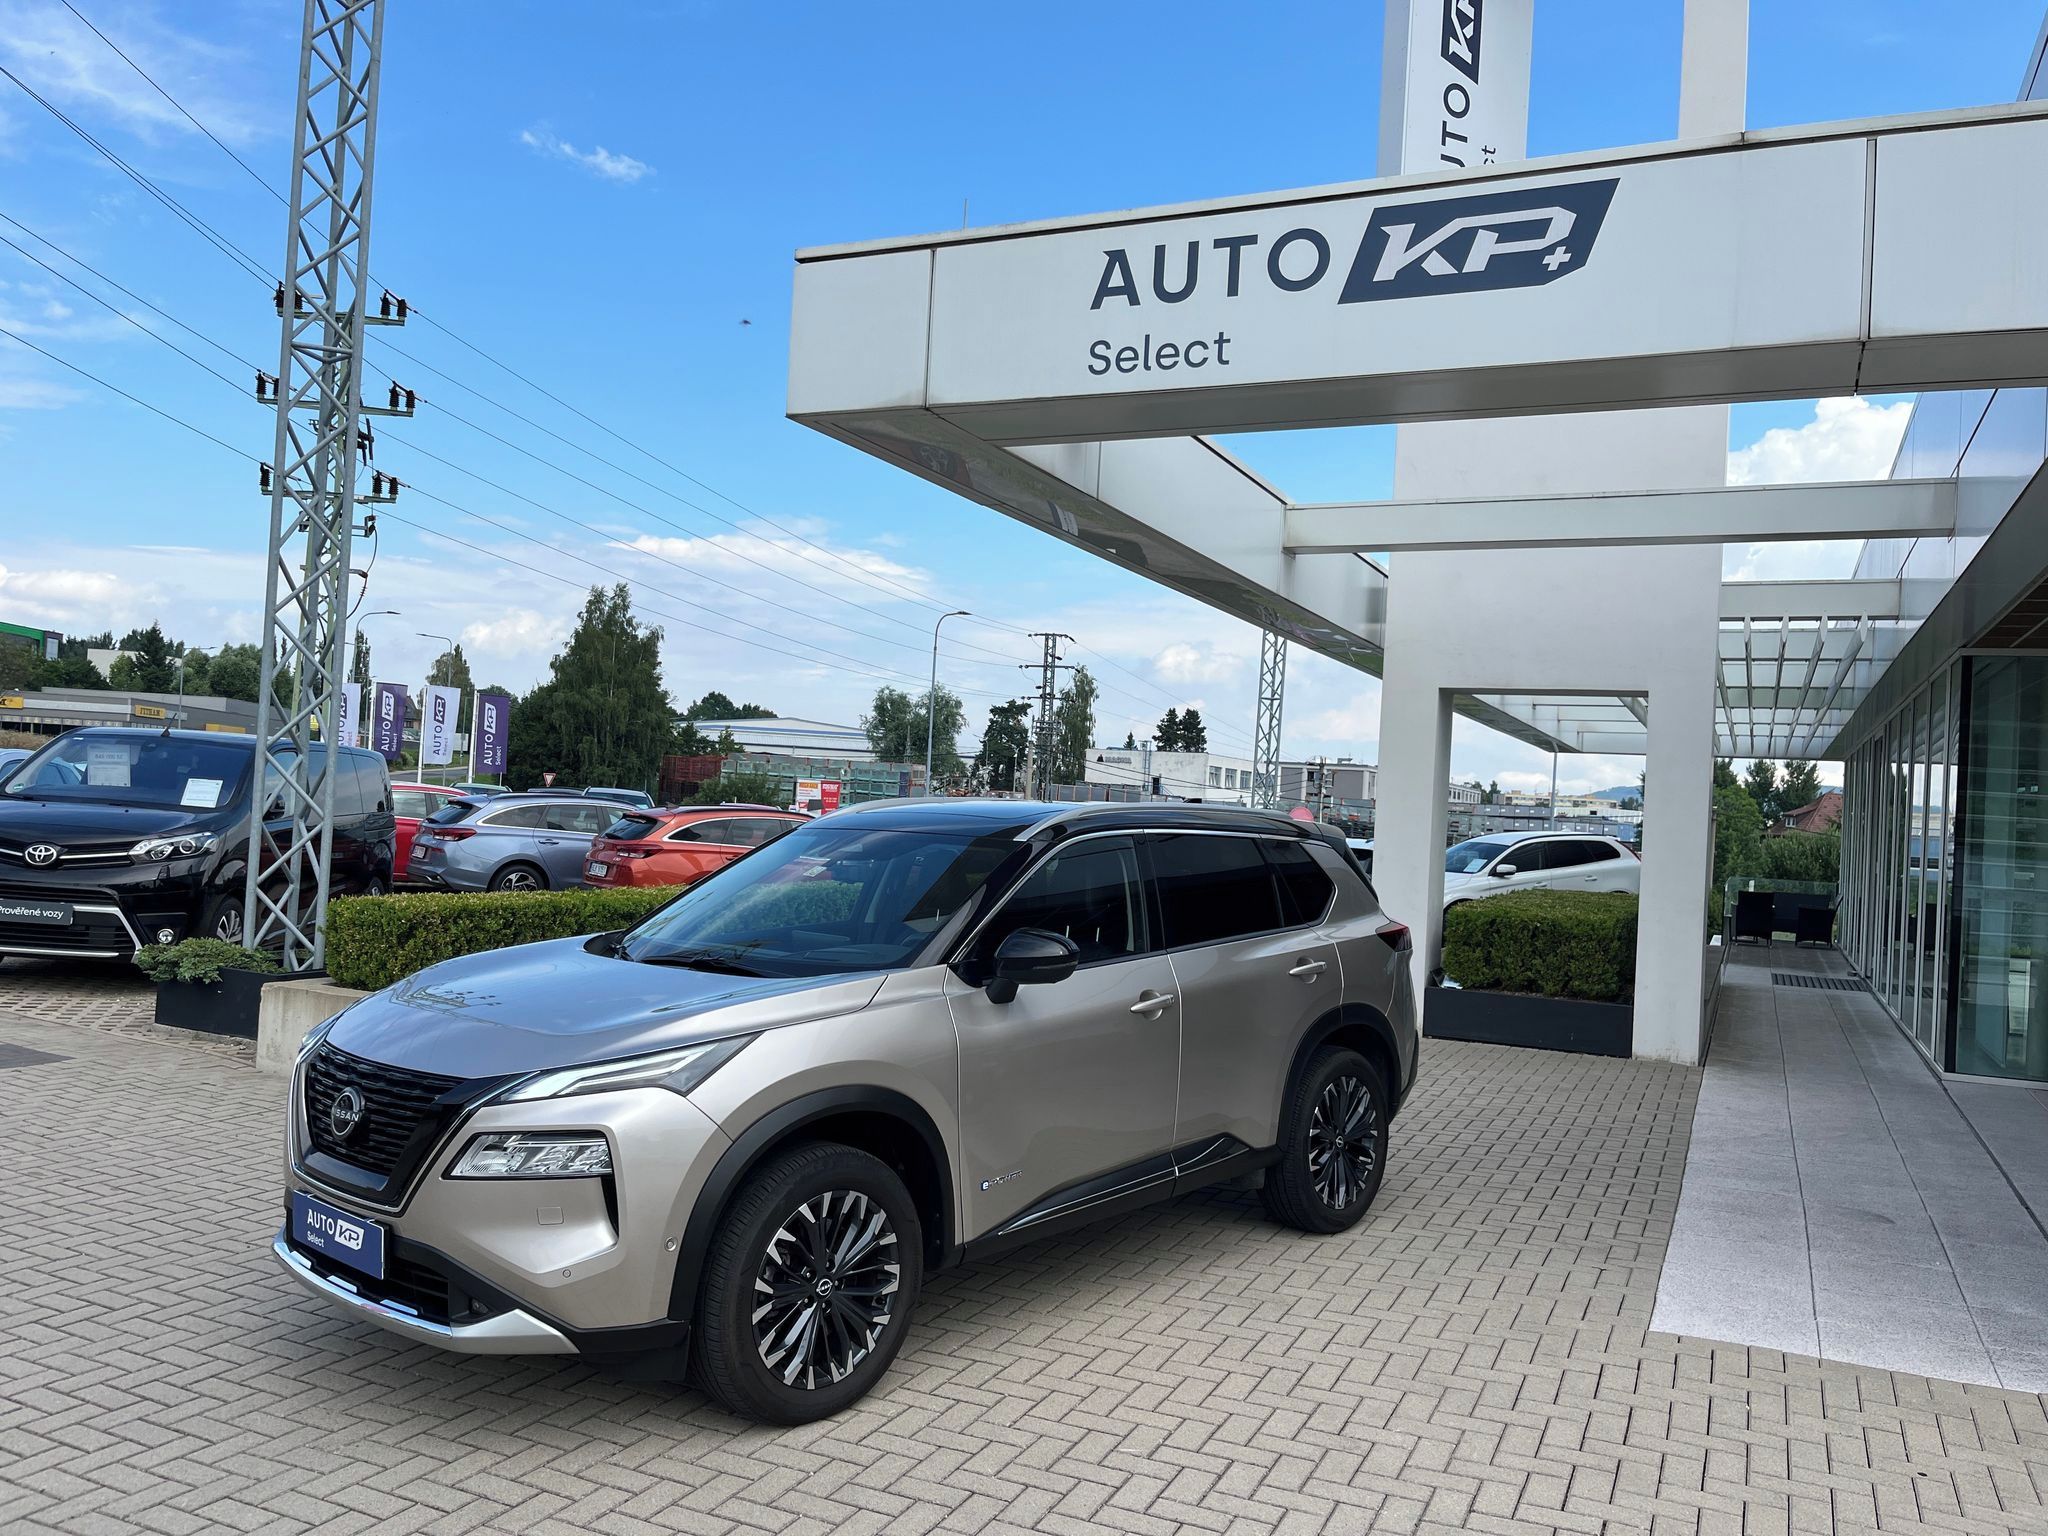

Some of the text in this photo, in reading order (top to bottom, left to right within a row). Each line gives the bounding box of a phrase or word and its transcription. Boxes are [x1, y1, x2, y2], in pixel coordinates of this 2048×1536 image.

[1090, 227, 1331, 311] AUTO
[1088, 331, 1231, 376] Select
[380, 721, 392, 752] AUTO
[433, 725, 443, 756] AUTO
[484, 733, 494, 765] AUTO
[42, 910, 64, 920] vozy
[307, 1208, 335, 1235] AUTO
[307, 1231, 325, 1248] Select
